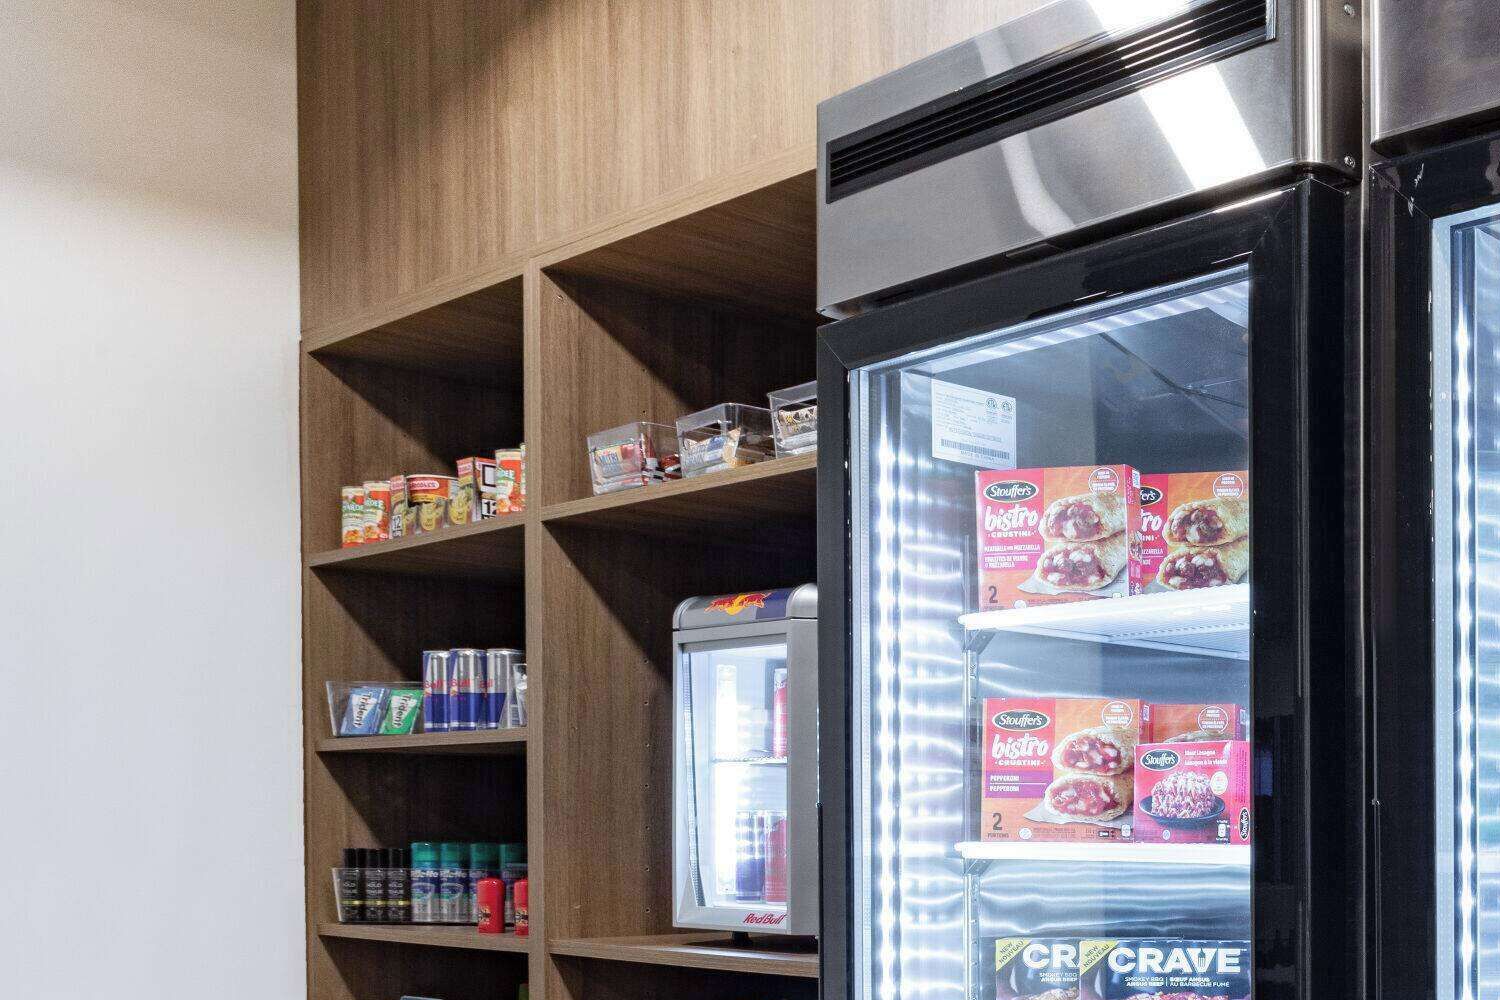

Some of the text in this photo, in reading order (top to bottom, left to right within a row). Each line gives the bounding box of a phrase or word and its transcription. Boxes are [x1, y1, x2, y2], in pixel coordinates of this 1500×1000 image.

[990, 485, 1032, 498] Stouffer's
[985, 505, 1038, 532] bistro
[988, 586, 998, 603] 2
[999, 714, 1043, 727] Stouffer's
[992, 733, 1049, 760] bistro
[1145, 753, 1175, 766] Stouffer's
[992, 812, 1003, 830] 2
[1107, 947, 1242, 974] CRAVE
